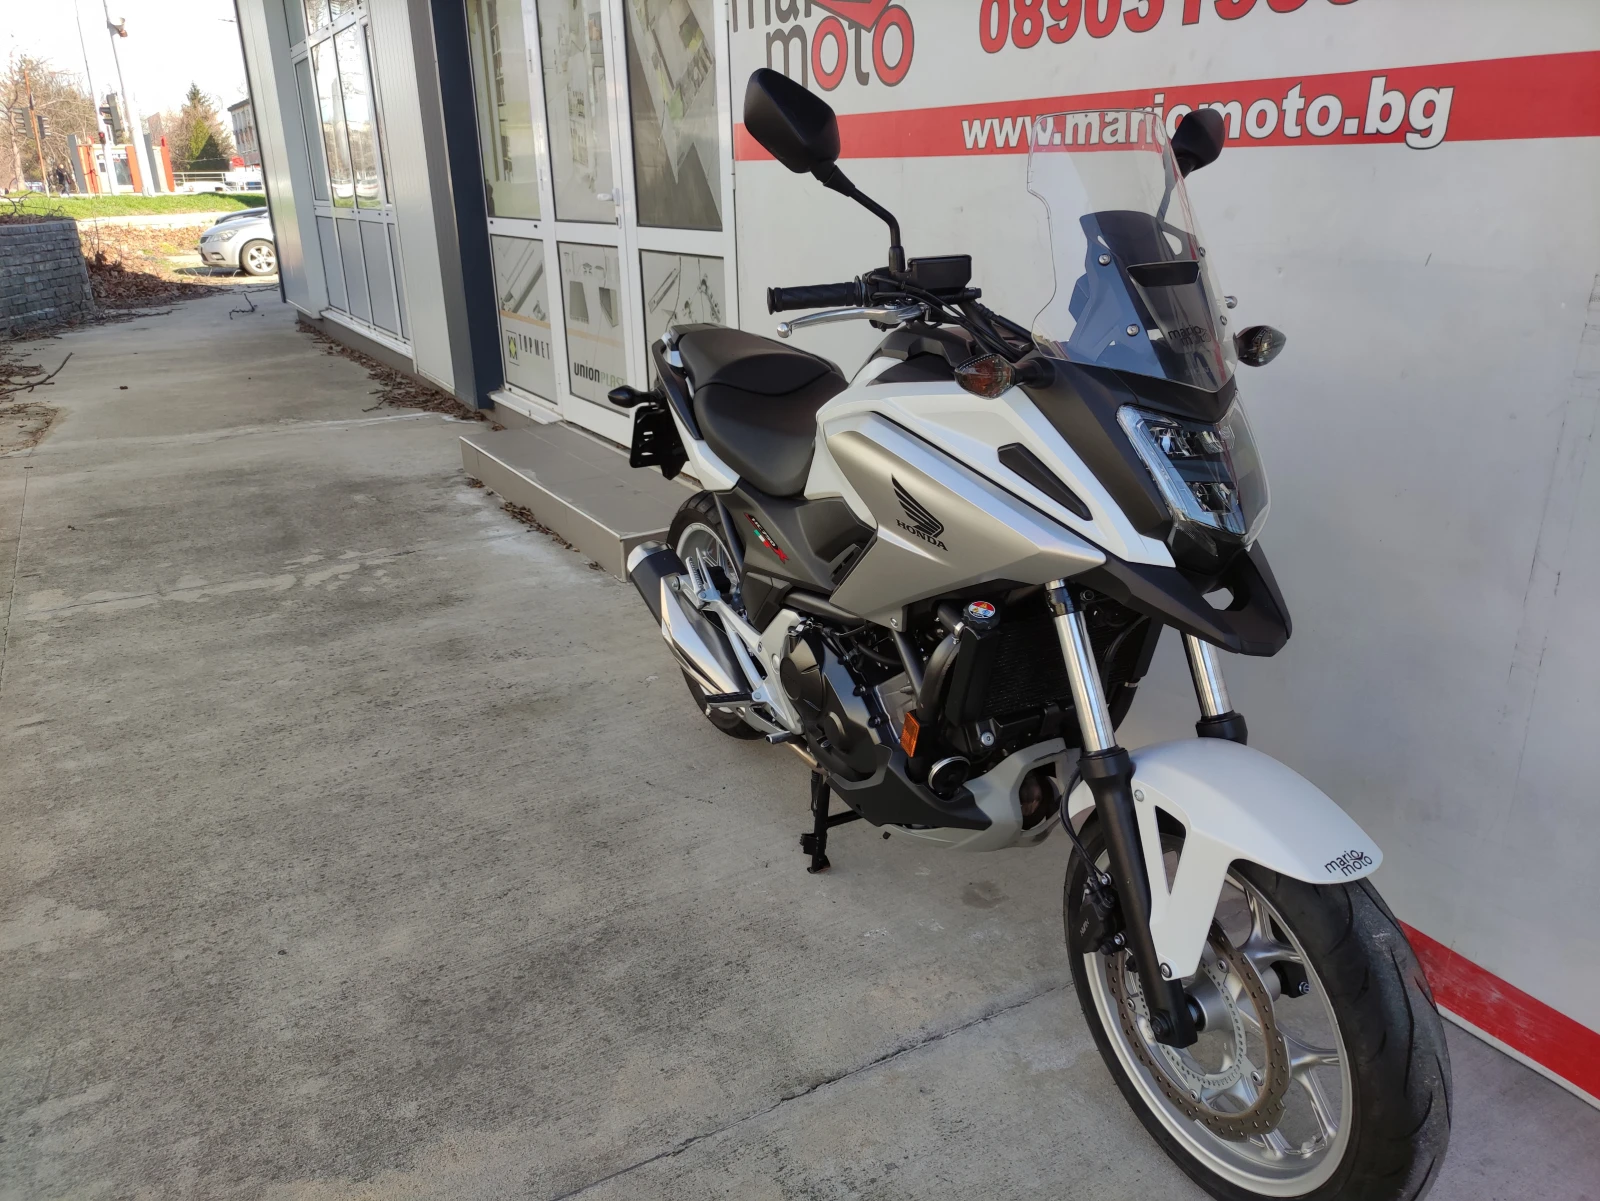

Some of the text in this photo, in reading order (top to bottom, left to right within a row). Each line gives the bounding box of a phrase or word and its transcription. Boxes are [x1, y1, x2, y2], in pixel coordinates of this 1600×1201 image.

[766, 4, 915, 92] moto
[1167, 324, 1202, 340] mario
[895, 518, 949, 552] HONDA
[1324, 849, 1360, 874] mario
[1340, 855, 1373, 877] moto
